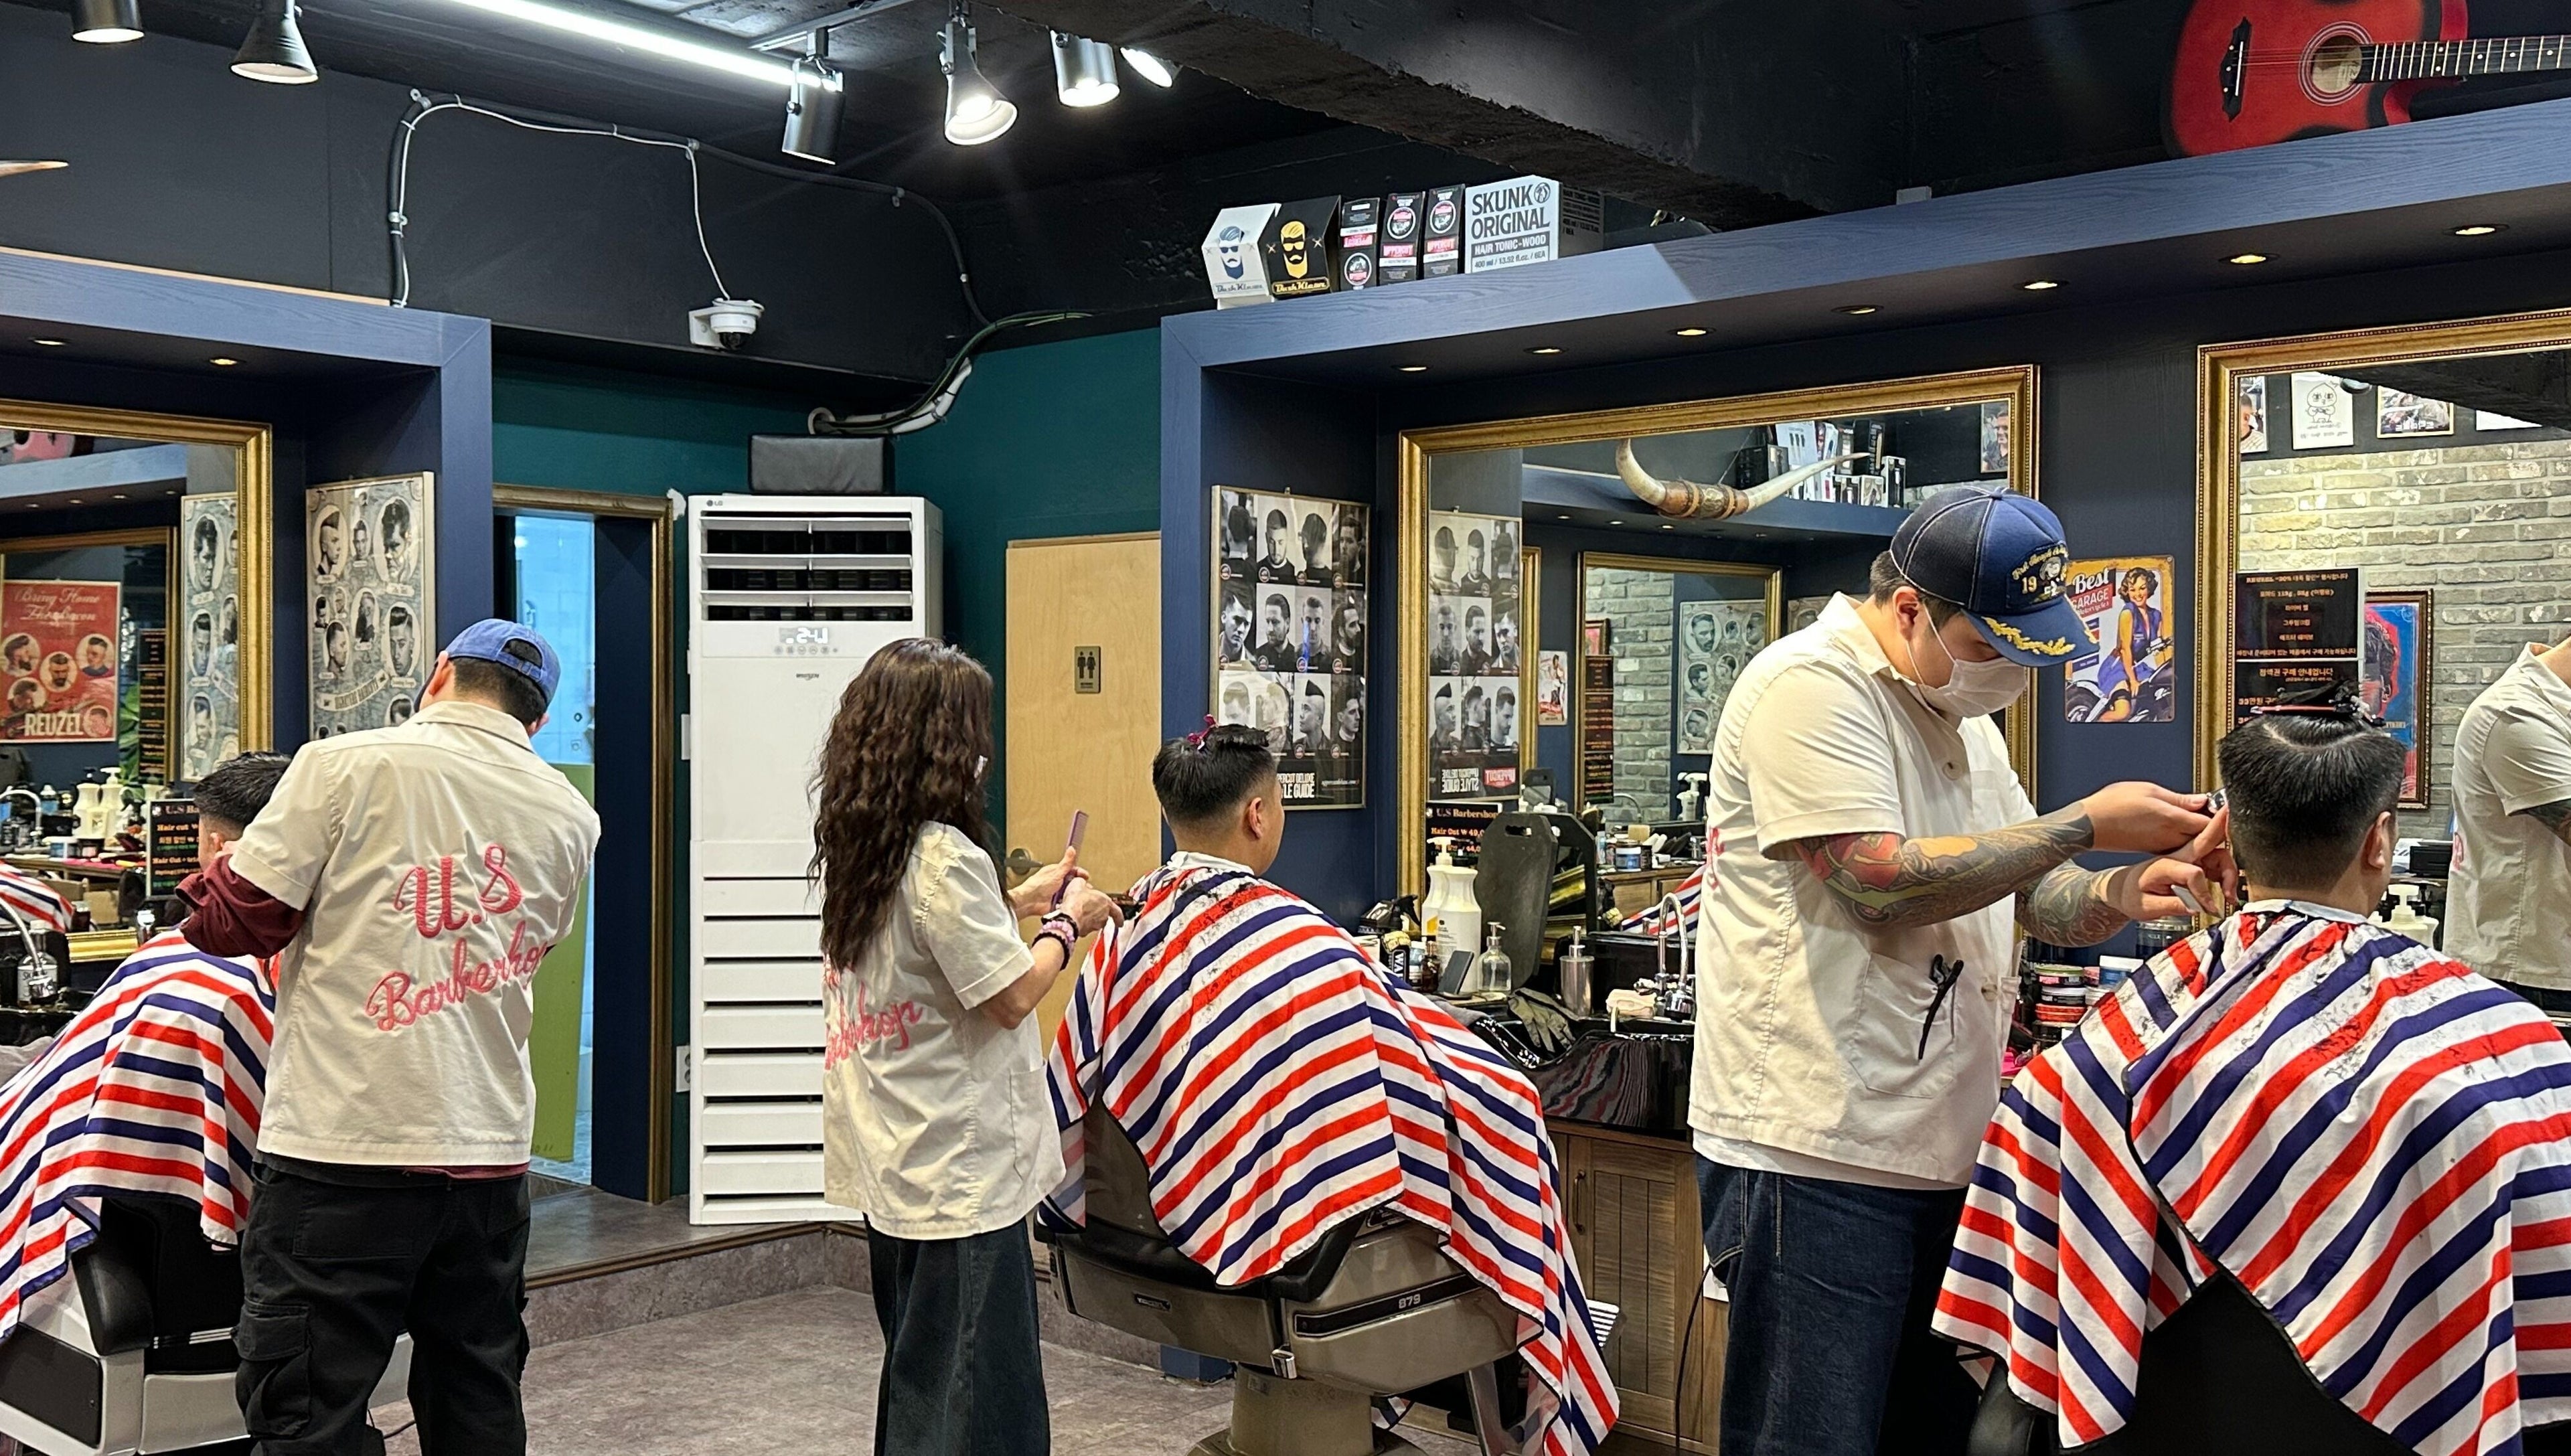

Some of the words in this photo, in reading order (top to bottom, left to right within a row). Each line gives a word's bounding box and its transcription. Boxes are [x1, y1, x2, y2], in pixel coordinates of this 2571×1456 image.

[1472, 184, 1534, 216] SKUNK
[1471, 207, 1550, 240] ORIGINAL
[1474, 243, 1494, 256] HAIR
[1495, 234, 1547, 252] TONIC-WOOD
[1474, 259, 1486, 268] 400
[1498, 255, 1514, 264] 13.52
[2022, 576, 2037, 594] 19
[2072, 567, 2109, 594] Best
[2282, 668, 2296, 676] 구매
[24, 712, 84, 736] REUZEL
[1294, 783, 1315, 798] GUIDE
[1431, 827, 1447, 835] Hair
[393, 842, 524, 939] U.S
[1398, 1293, 1421, 1309] 879
